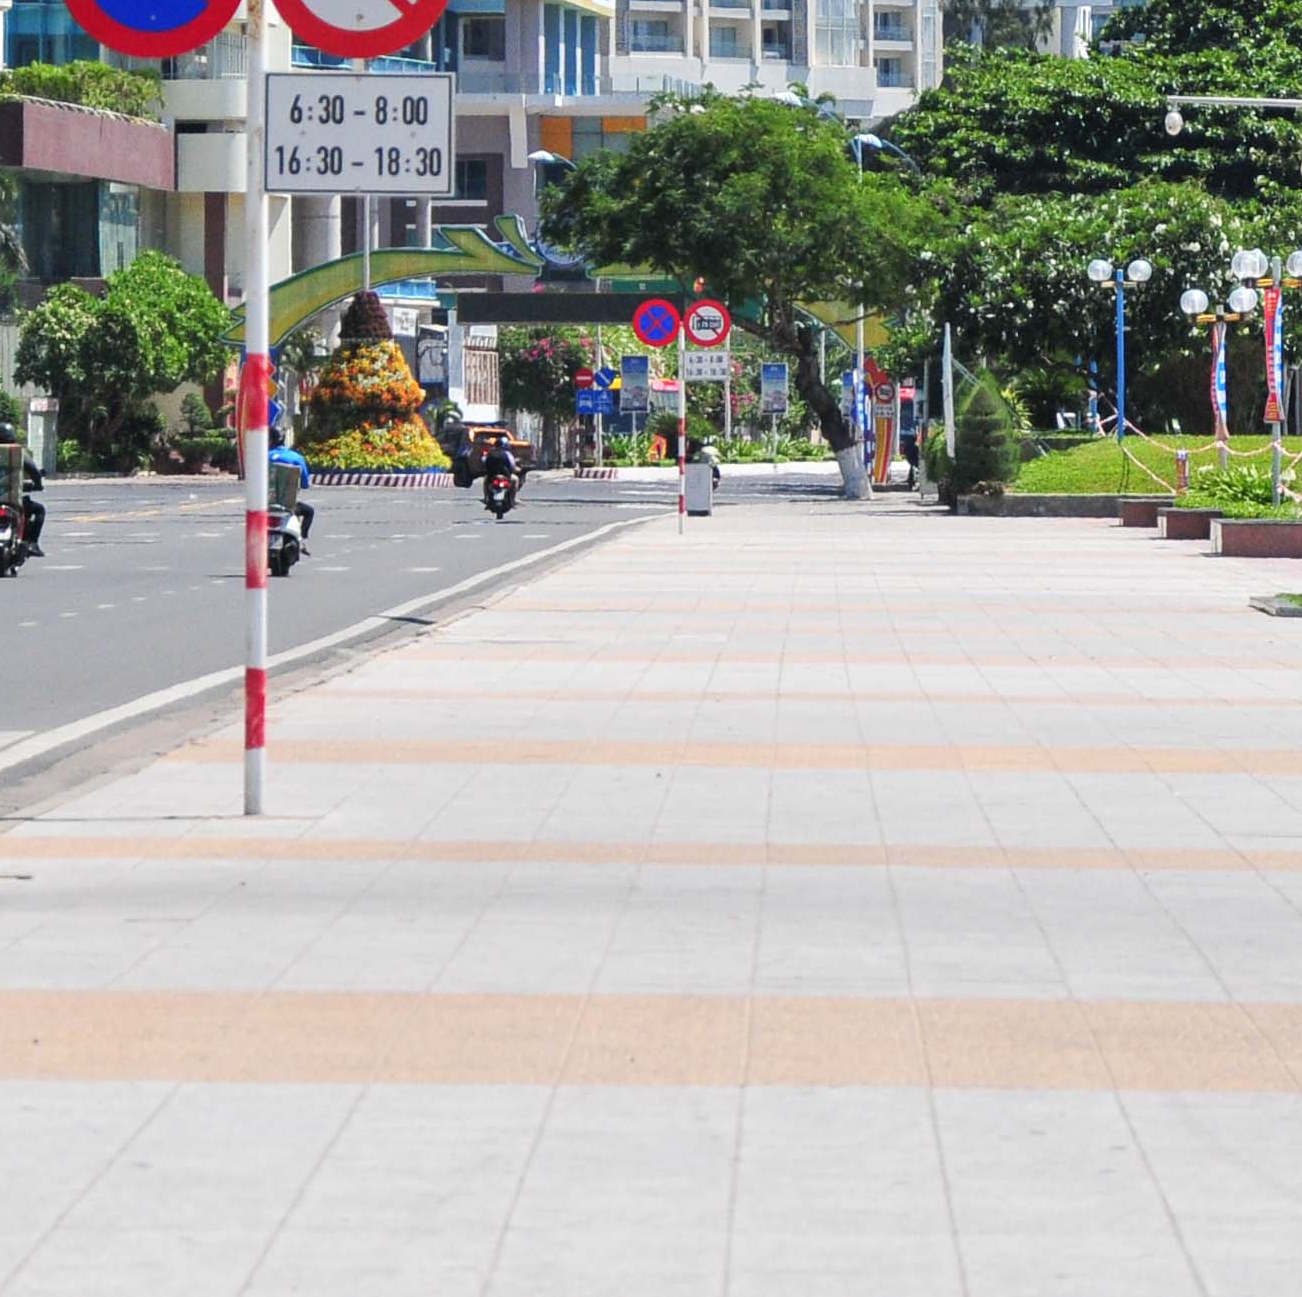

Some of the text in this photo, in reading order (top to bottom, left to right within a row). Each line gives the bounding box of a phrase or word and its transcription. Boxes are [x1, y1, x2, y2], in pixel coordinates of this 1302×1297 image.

[290, 94, 345, 125] 6:30
[375, 95, 428, 125] 8:00
[275, 145, 344, 175] 16:30
[374, 146, 442, 177] 18:30
